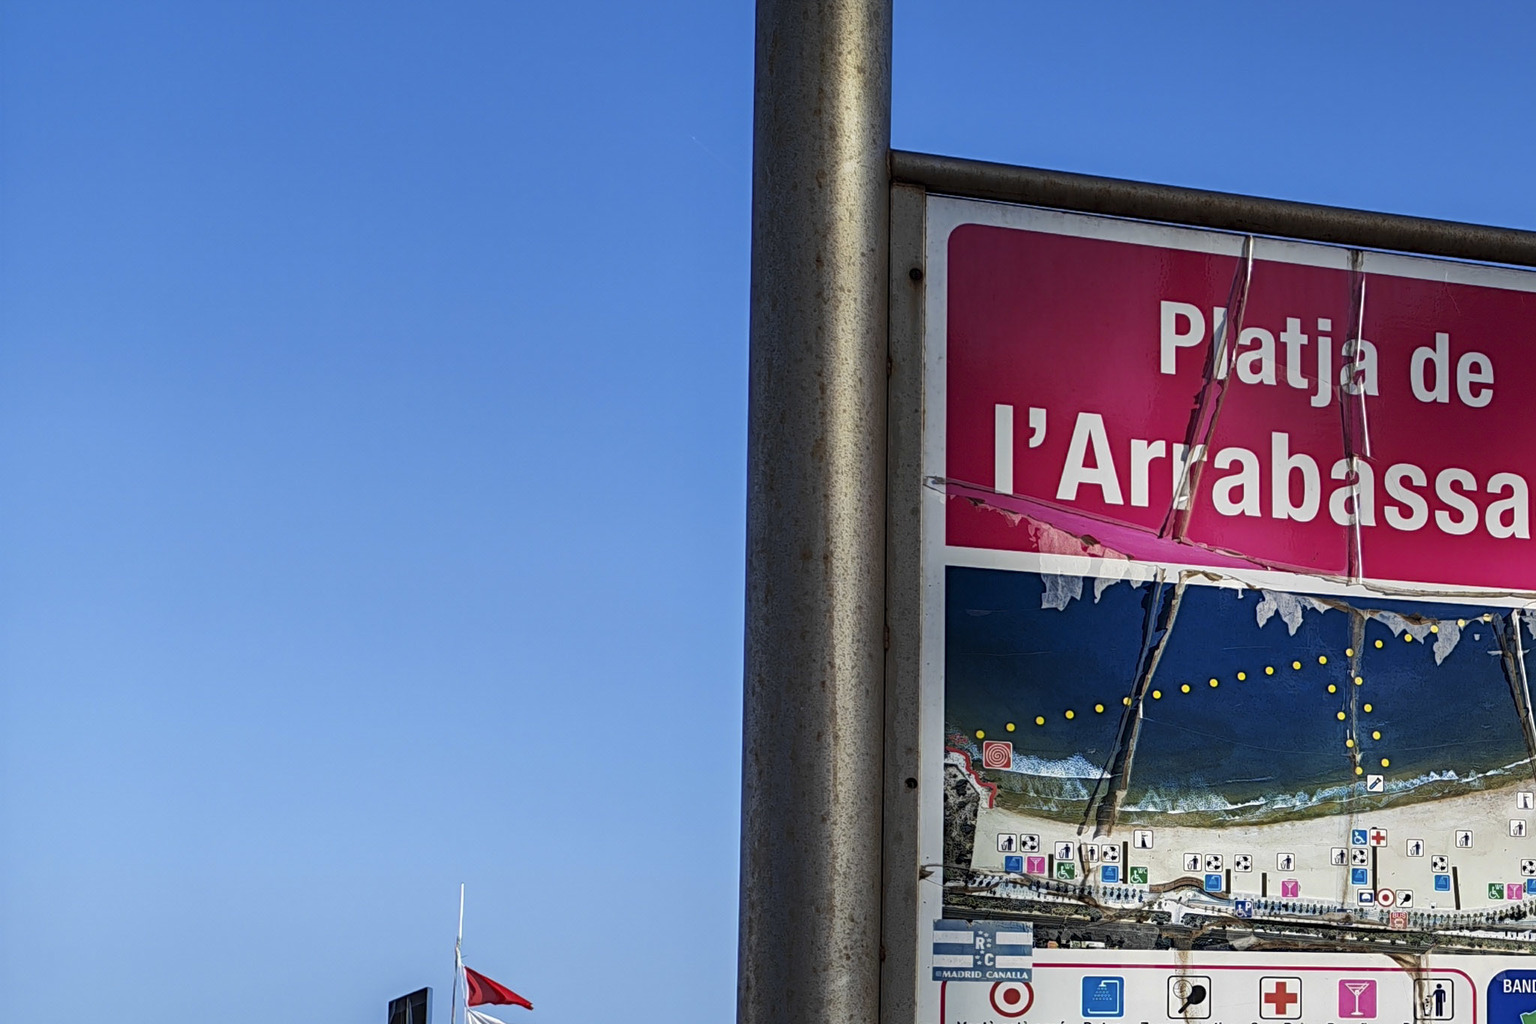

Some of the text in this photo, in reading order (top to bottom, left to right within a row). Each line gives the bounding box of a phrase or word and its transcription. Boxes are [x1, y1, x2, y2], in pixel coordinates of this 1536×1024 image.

[1160, 299, 1495, 409] Platja de
[975, 936, 985, 949] R
[984, 953, 995, 966] C
